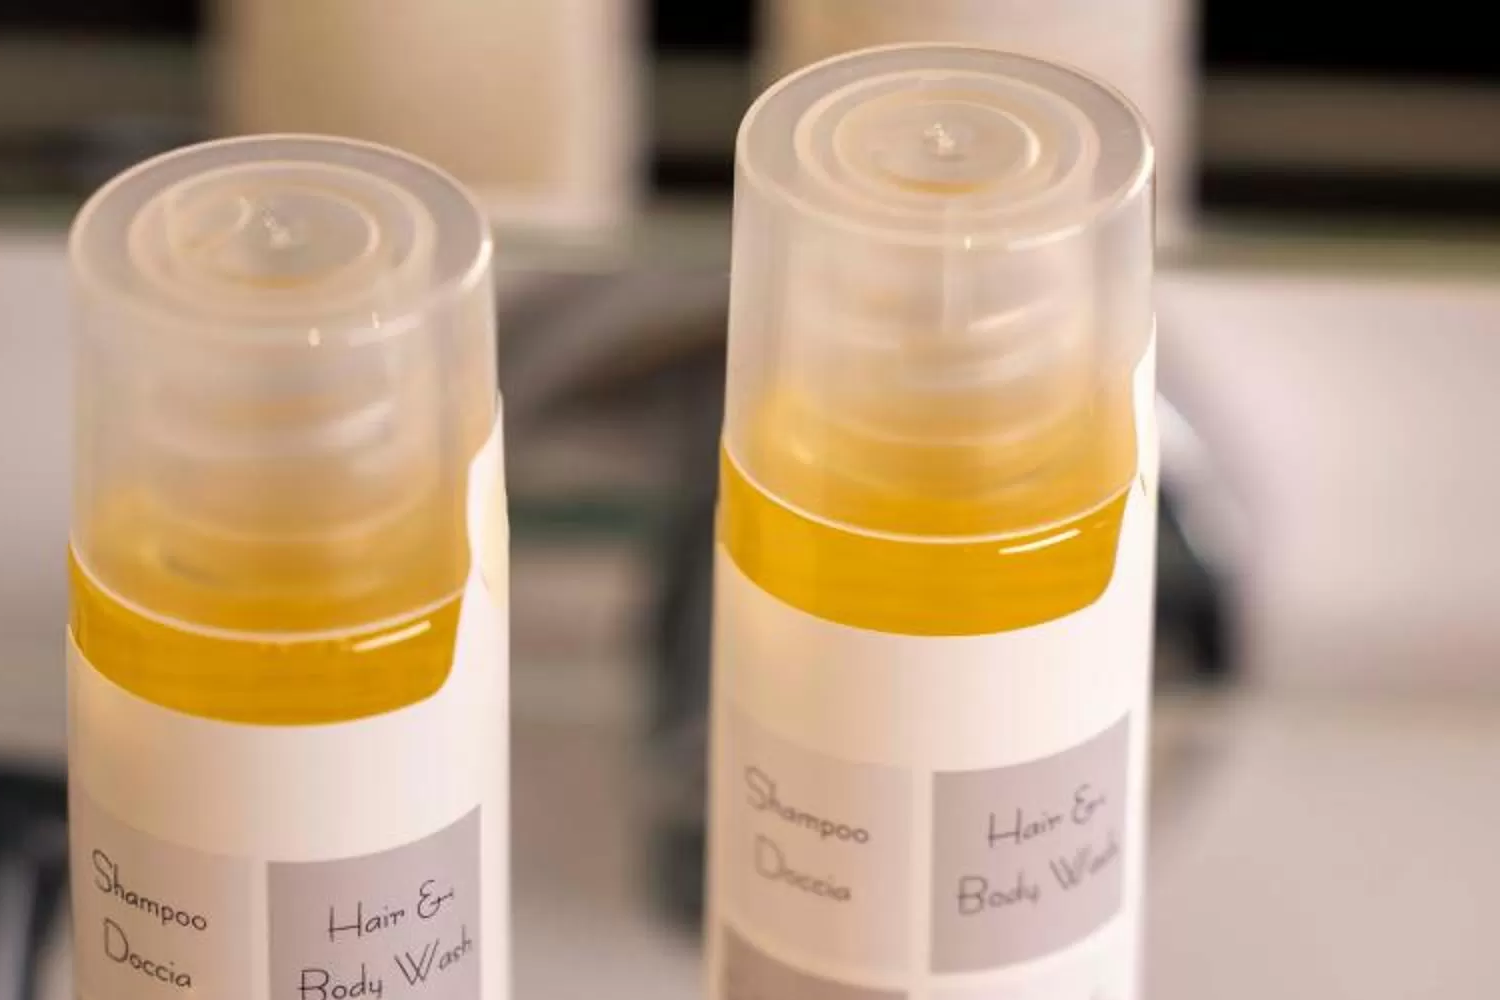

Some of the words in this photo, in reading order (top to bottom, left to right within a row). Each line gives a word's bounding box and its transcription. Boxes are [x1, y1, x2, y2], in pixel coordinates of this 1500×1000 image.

[743, 765, 869, 844] Shampoo
[987, 807, 1063, 848] Hair
[91, 848, 208, 931] Shampoo
[754, 832, 852, 901] Doccia
[957, 868, 1041, 917] Body
[103, 916, 192, 988] Doccia
[328, 900, 406, 943] Hair
[393, 923, 474, 986] Wash
